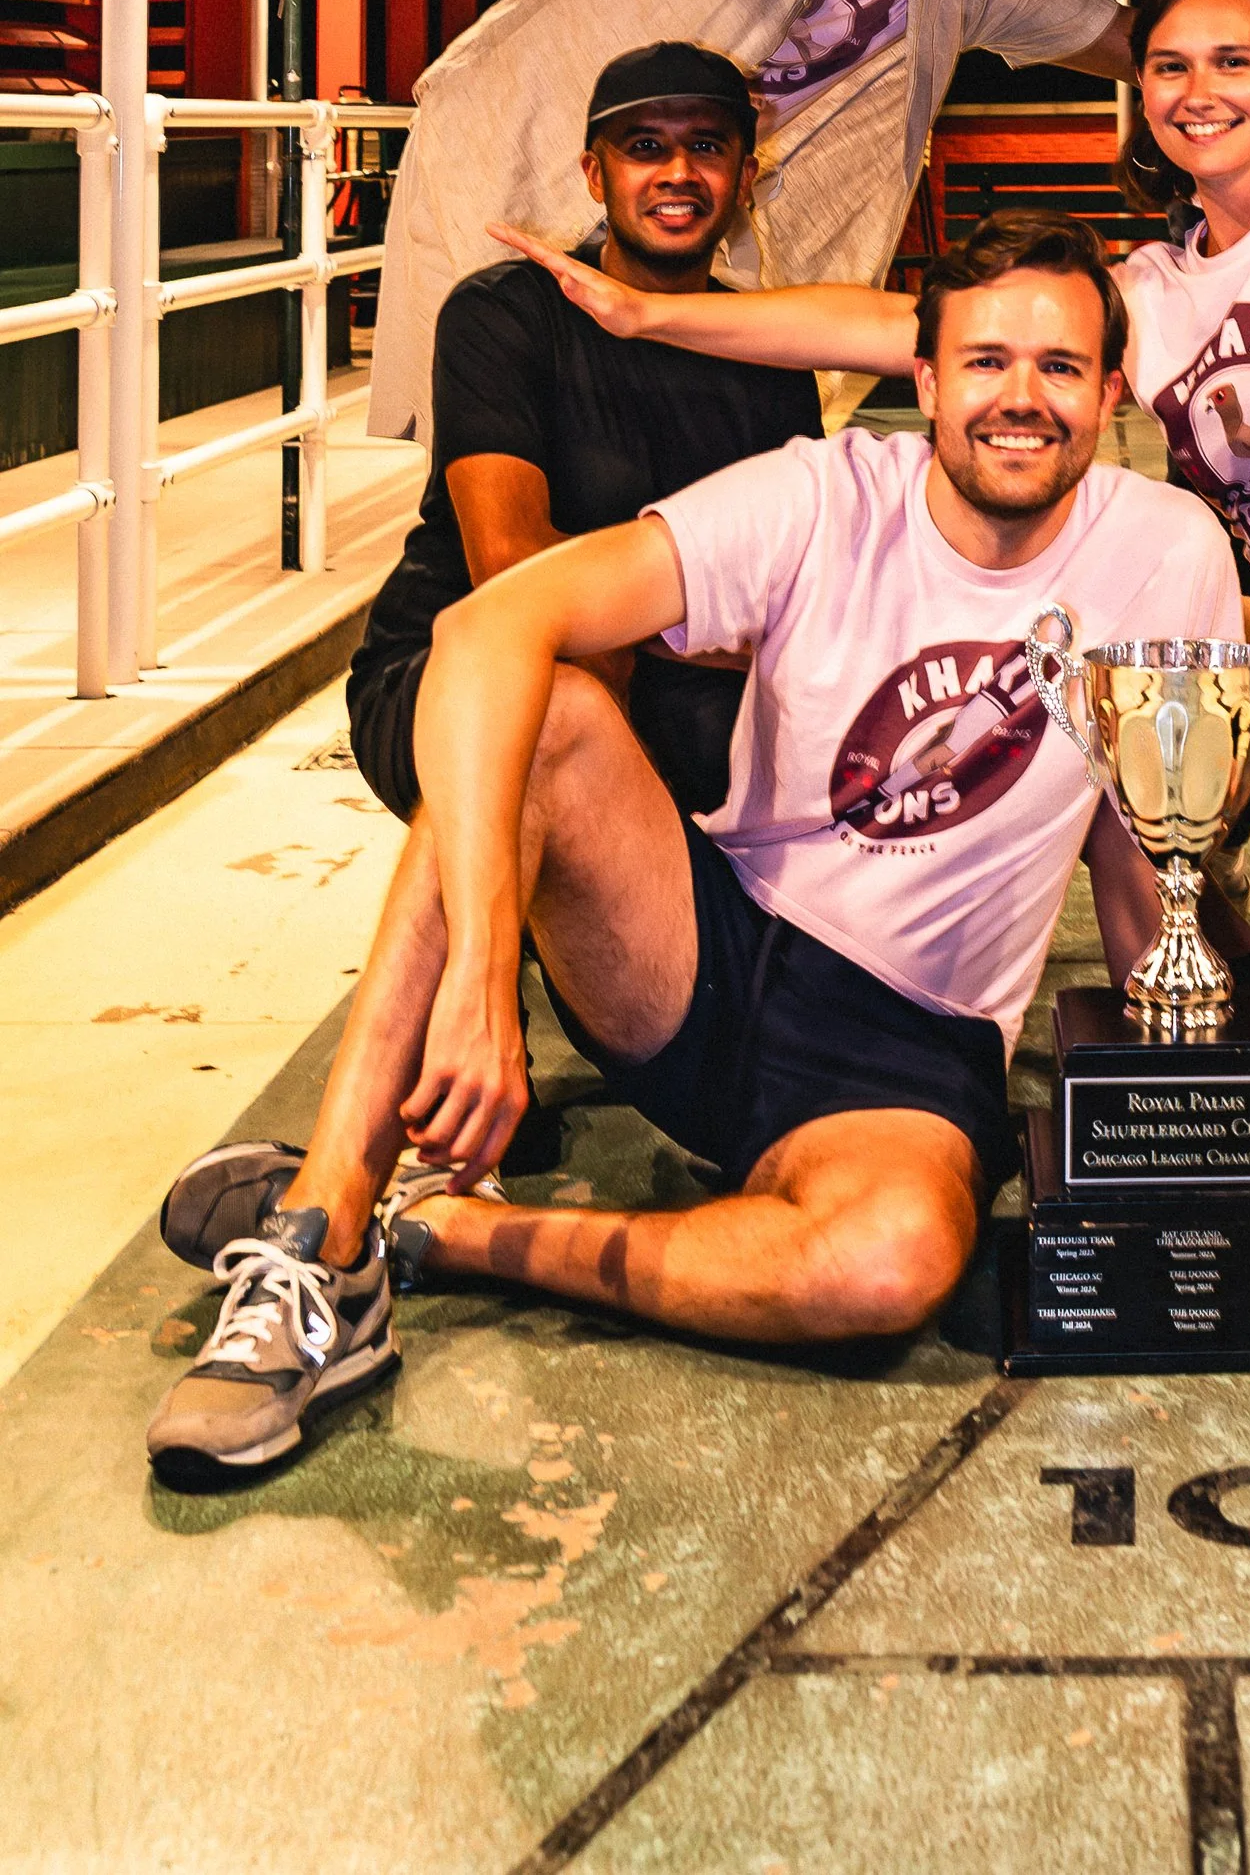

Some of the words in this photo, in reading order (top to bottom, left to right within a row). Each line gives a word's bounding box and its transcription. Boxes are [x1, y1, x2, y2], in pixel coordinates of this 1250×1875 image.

[1038, 1236, 1056, 1246] THE
[1057, 1236, 1087, 1246] HOUSE
[1089, 1235, 1115, 1247] TEAM
[1057, 1249, 1078, 1259] Spring
[1050, 1273, 1090, 1282] CHICAGO
[1056, 1285, 1080, 1295] Winter
[1037, 1309, 1056, 1319] THE
[1057, 1308, 1117, 1320] HANDSHAKES
